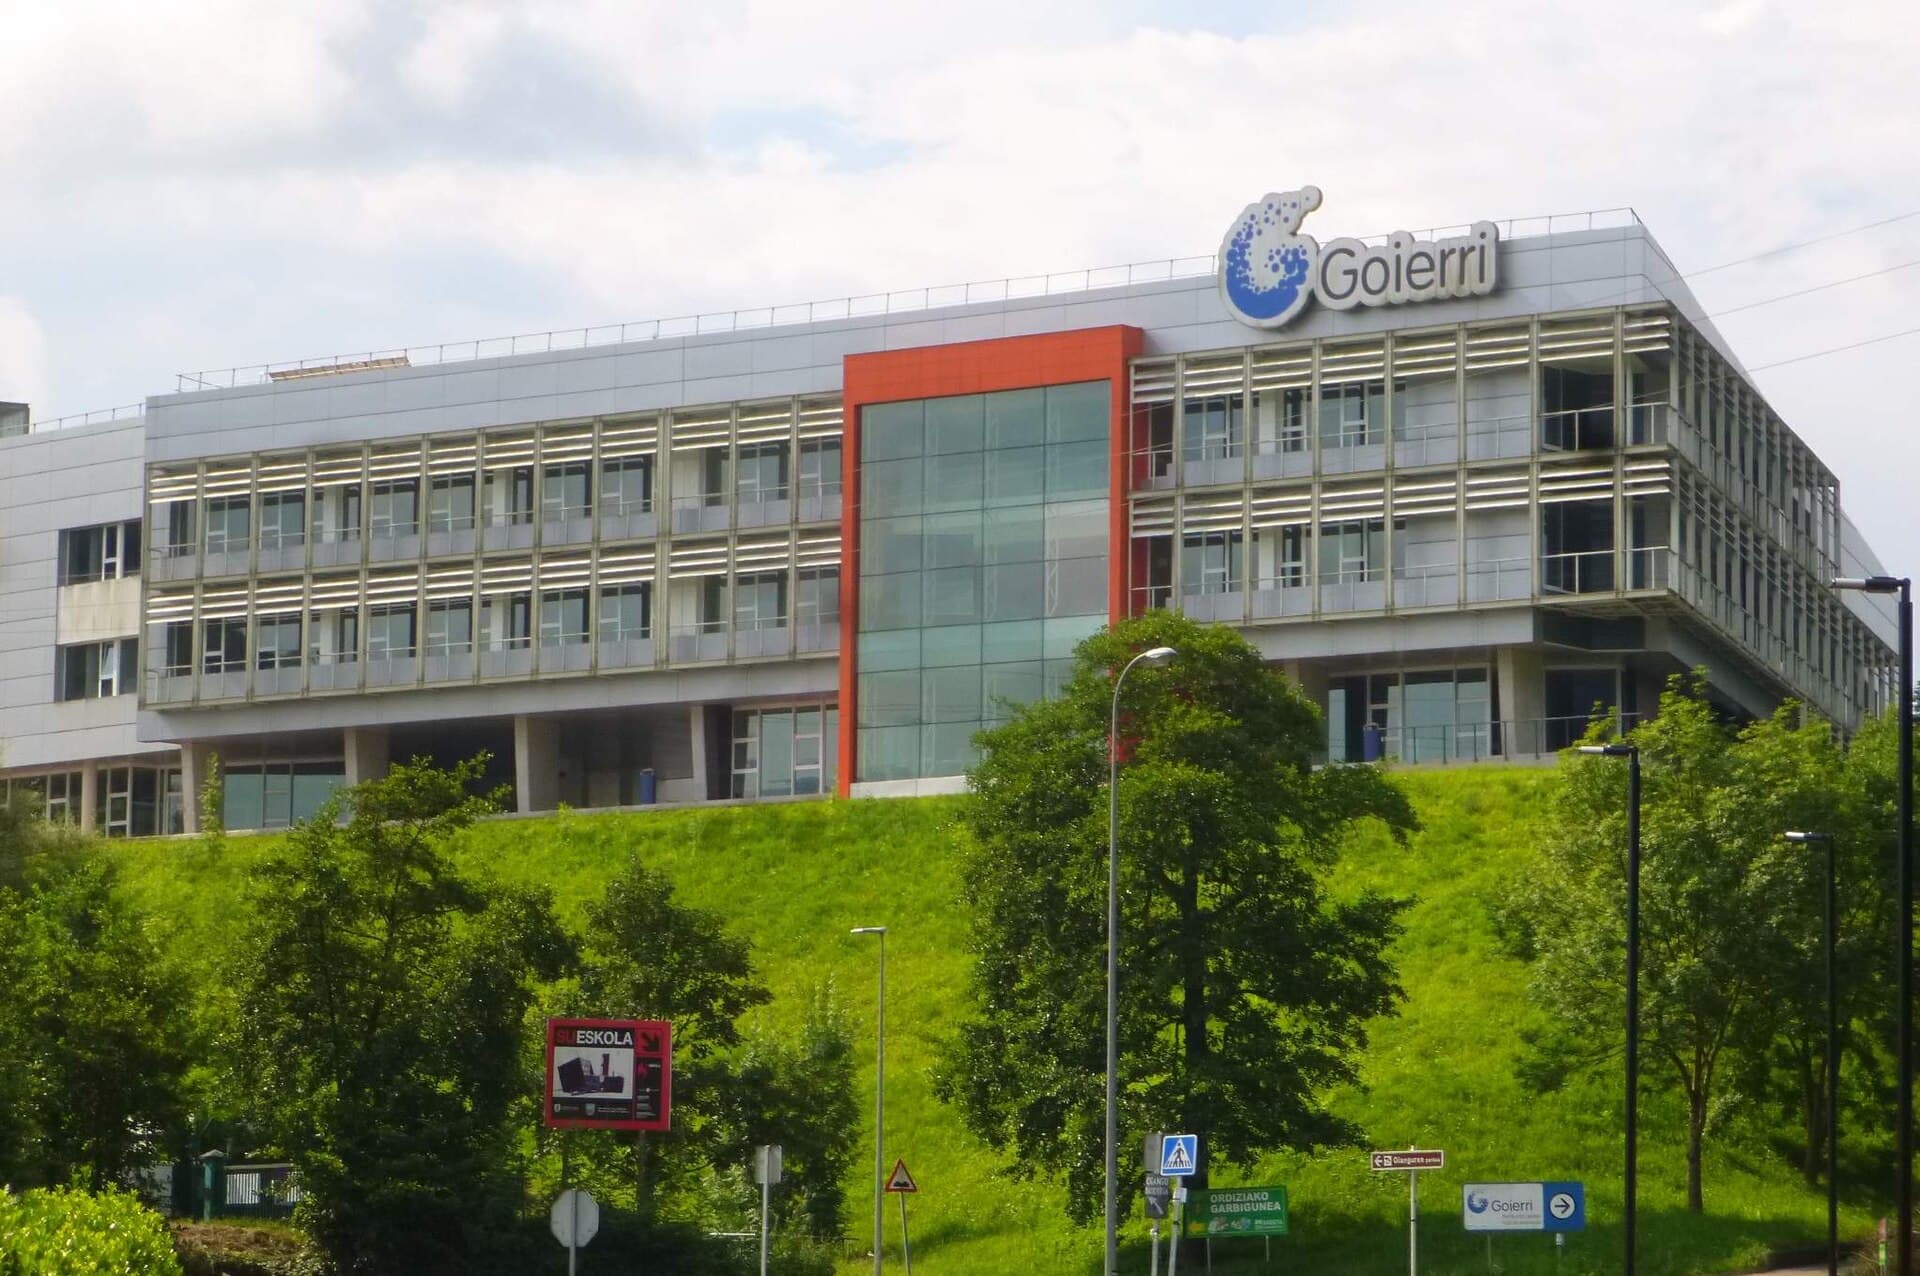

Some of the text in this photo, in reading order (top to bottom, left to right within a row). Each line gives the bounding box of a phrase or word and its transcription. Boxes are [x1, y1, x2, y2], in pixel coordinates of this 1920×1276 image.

[1321, 231, 1488, 301] Goierri
[1210, 1191, 1269, 1204] ORDIZIAKO
[1210, 1201, 1281, 1214] GARBIGUNEA
[1491, 1199, 1533, 1213] Goierri
